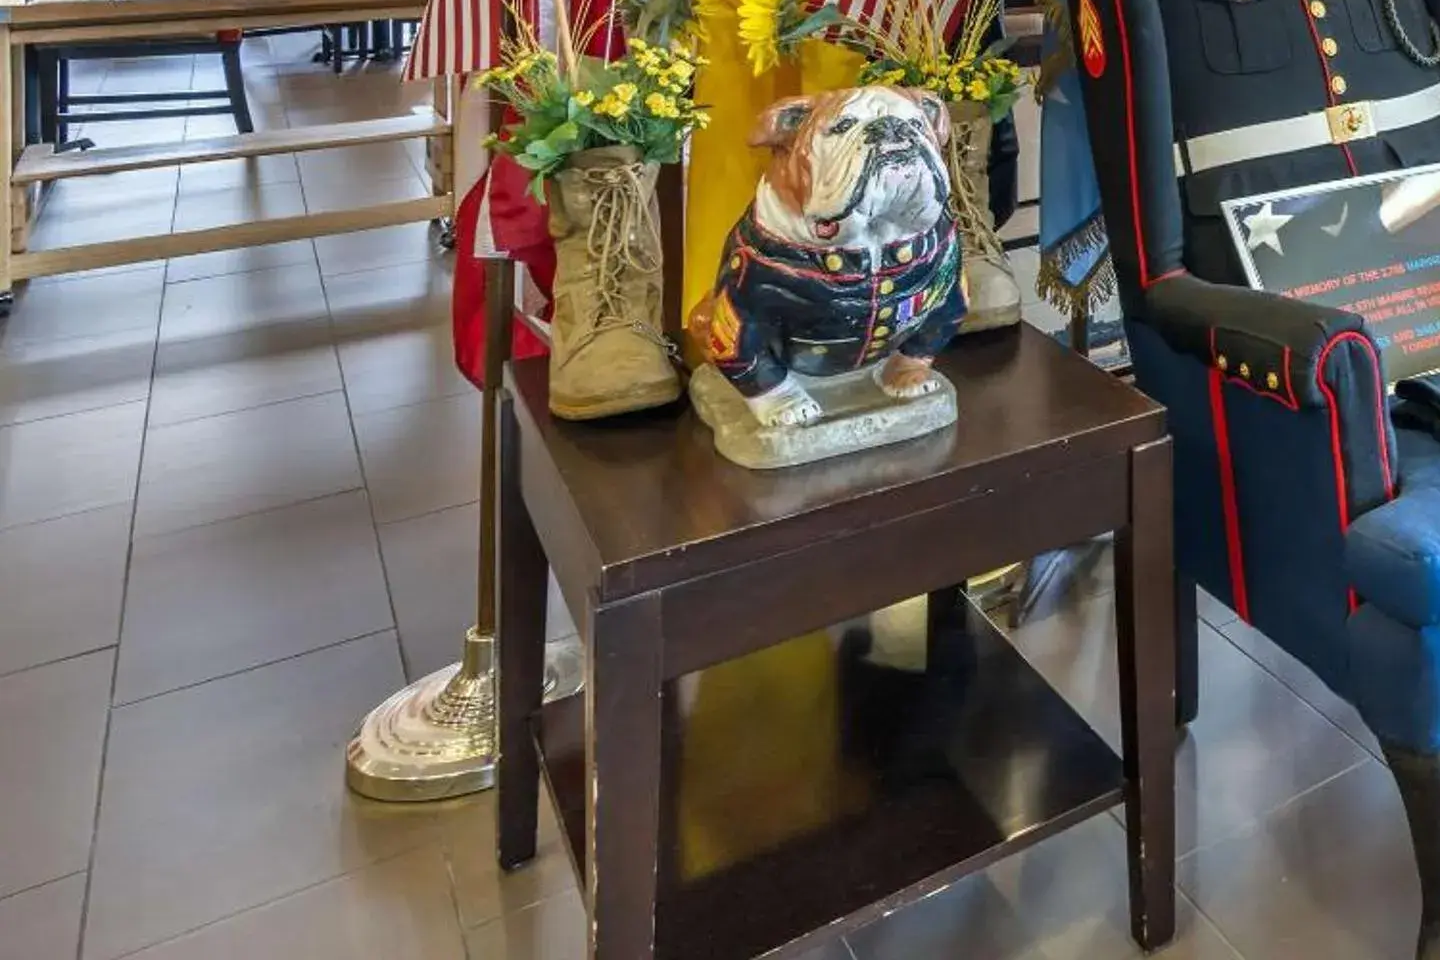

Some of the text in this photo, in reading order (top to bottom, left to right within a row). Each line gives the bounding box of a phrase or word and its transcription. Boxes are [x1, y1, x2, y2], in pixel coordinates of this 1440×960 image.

[1294, 278, 1341, 297] MEMORY
[1343, 273, 1356, 285] OF
[1358, 269, 1380, 281] THE
